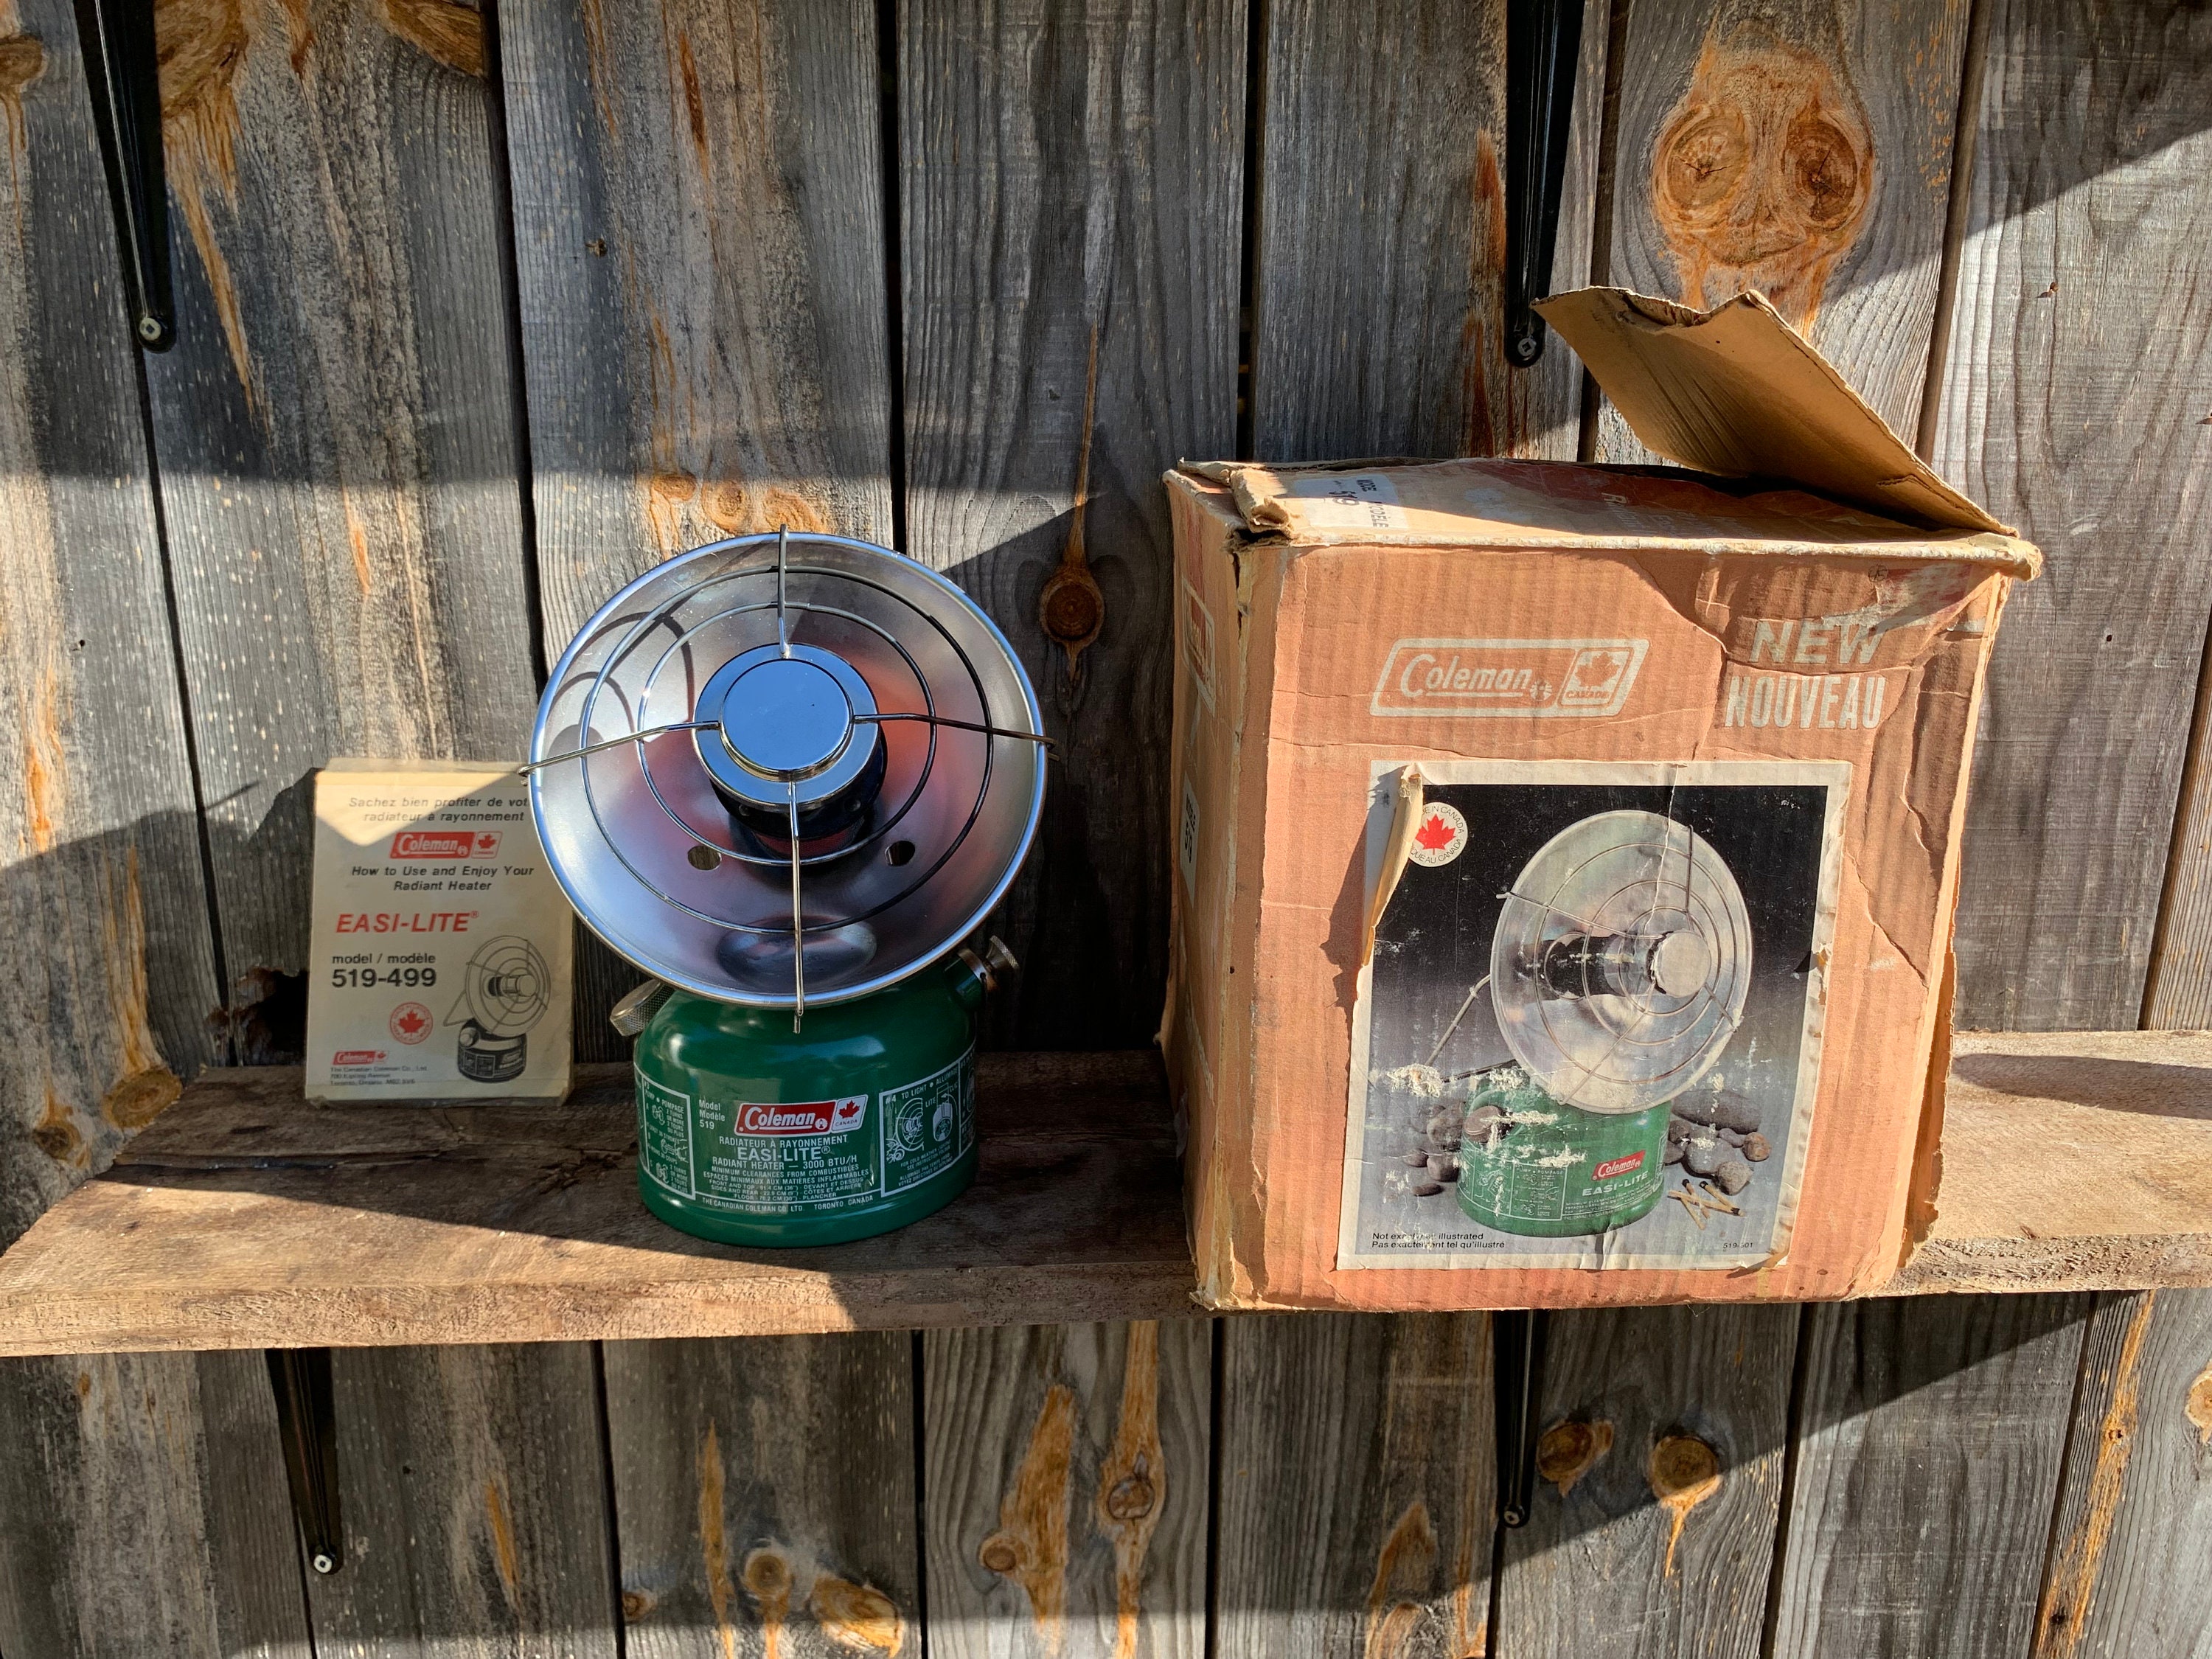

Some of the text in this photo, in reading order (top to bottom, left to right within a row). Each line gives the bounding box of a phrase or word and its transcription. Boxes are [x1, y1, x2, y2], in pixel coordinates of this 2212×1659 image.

[1749, 619, 1885, 664] NEW
[1401, 653, 1533, 698] Coleman
[1725, 675, 1886, 730] NOUVEAU
[349, 797, 529, 810] Sachez bien profiter de vot
[364, 812, 422, 821] radiateur
[441, 812, 524, 823] rayonnement
[1441, 807, 1464, 833] CANADA
[398, 833, 459, 855] Coleman
[1438, 839, 1463, 862] CANADA
[352, 866, 534, 878] How to Use and Enjoy Your
[394, 881, 492, 891] Radiant Heater
[333, 953, 372, 964] model
[387, 953, 436, 964] modèle
[332, 967, 437, 988] 519-499
[886, 1094, 896, 1105] #4
[902, 1091, 909, 1099] TO
[911, 1084, 927, 1096] LIGHT
[662, 1099, 684, 1114] POMPAGE
[699, 1099, 720, 1110] Model
[925, 1097, 936, 1107] LITE
[699, 1109, 725, 1121] Modèle
[745, 1106, 815, 1130] Coleman
[699, 1120, 714, 1130] 519
[835, 1119, 858, 1127] CANADA
[719, 1135, 847, 1148] RADIATEUR À RAYONNEMENT
[712, 1155, 857, 1170] RADIANT HEATER 3000 BTU/H
[1598, 1159, 1635, 1178] Coleman
[703, 1171, 728, 1180] ESPACES
[731, 1176, 764, 1184] MINIMAUX
[782, 1177, 815, 1185] MATIÈRES
[818, 1169, 869, 1183] INFLAMMABLES
[712, 1166, 740, 1175] MINIMUM
[742, 1170, 785, 1178] CLEARANCES
[809, 1164, 859, 1177] COMBUSTIBLES
[840, 1177, 863, 1186] DESSUS
[898, 1178, 911, 1186] VOYEZ
[1582, 1170, 1649, 1197] EASI-LITE
[703, 1197, 713, 1206] THE
[714, 1200, 744, 1210] CANADIAN
[814, 1200, 844, 1210] TORONTO
[848, 1194, 873, 1206] CANADA
[803, 1192, 837, 1200] PLANCHER
